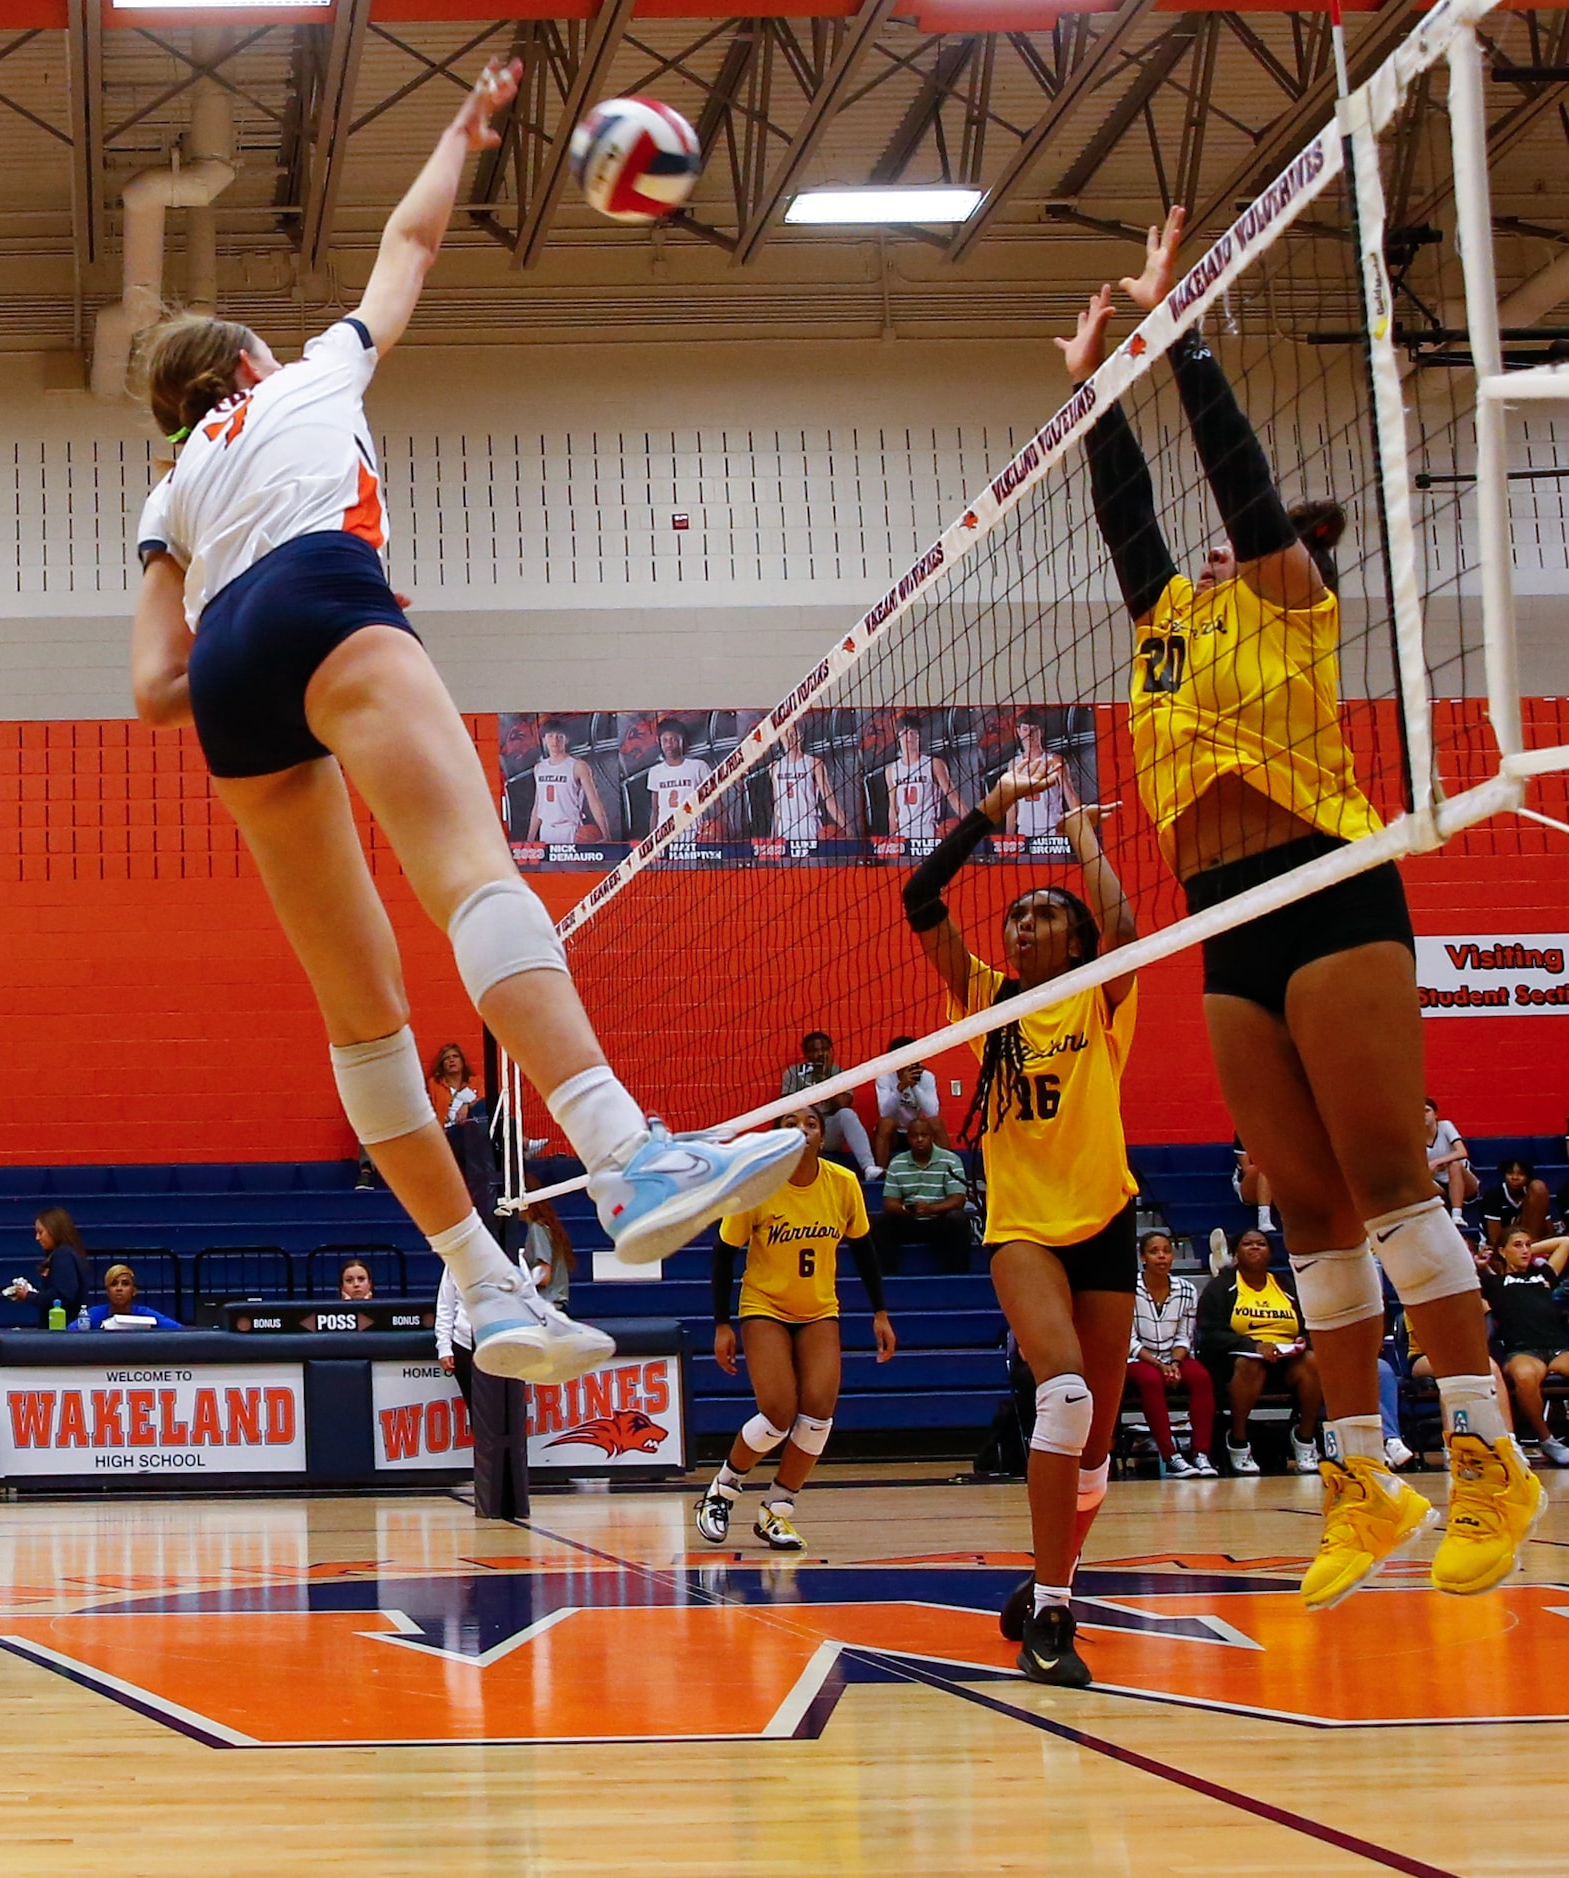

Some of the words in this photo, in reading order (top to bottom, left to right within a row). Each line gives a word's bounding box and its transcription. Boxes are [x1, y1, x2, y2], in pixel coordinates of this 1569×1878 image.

[1140, 635, 1186, 693] 20
[668, 790, 679, 808] 2
[549, 844, 577, 853] NICK
[790, 840, 818, 849] LUKE
[1031, 837, 1069, 846] AUSTIN
[548, 851, 604, 862] DEMAURO
[669, 850, 722, 860] HAMPTON
[910, 847, 935, 856] TUD
[1030, 845, 1071, 855] BROWN
[1444, 942, 1565, 974] Visiting
[1417, 984, 1510, 1008] Student
[1514, 983, 1569, 1006] Secti
[1015, 1073, 1062, 1122] 16
[766, 1221, 841, 1248] Warriors
[798, 1247, 816, 1278] 6
[1235, 1307, 1295, 1320] VOLLEYBALL
[253, 1318, 282, 1329] BONUS
[317, 1314, 357, 1330] POSS
[392, 1315, 421, 1326] BONUS
[106, 1371, 172, 1382] WELCOME
[174, 1371, 192, 1382] TO
[402, 1367, 440, 1379] HOME
[6, 1386, 296, 1449] WAKELAND
[95, 1455, 134, 1468] HIGH
[139, 1453, 206, 1468] SCHOOL
